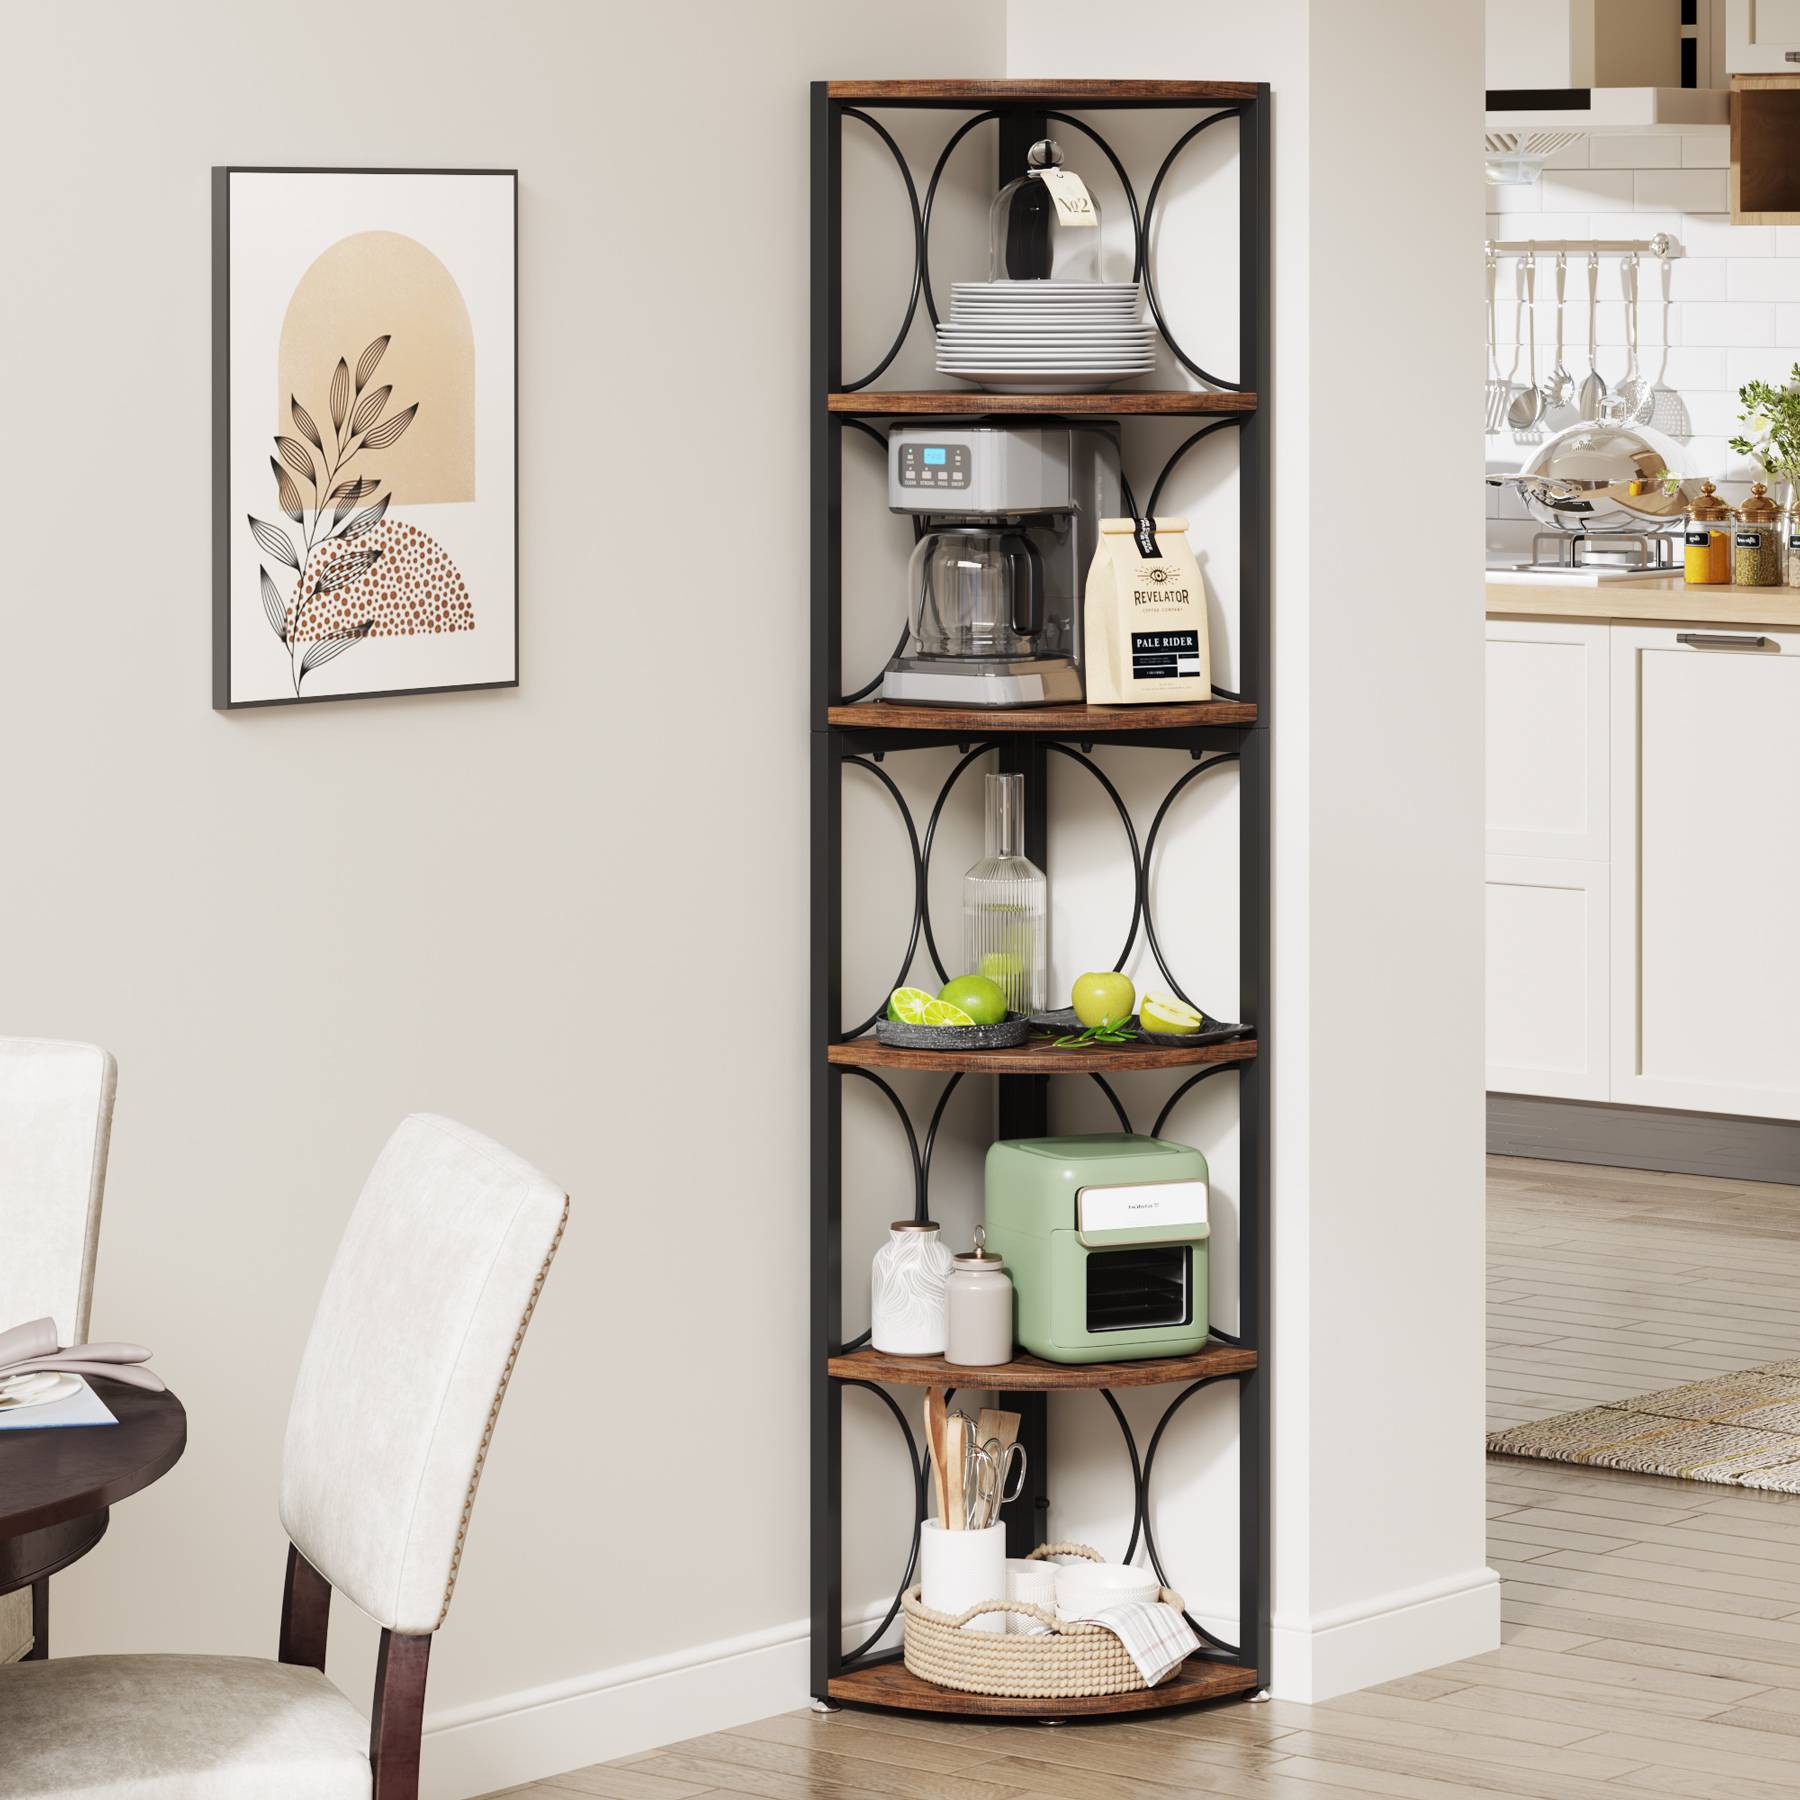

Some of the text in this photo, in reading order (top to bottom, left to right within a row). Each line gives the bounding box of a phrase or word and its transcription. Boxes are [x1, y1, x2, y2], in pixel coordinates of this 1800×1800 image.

[1133, 589, 1190, 606] REVELATOR
[1136, 636, 1193, 648] PALE RIDER
